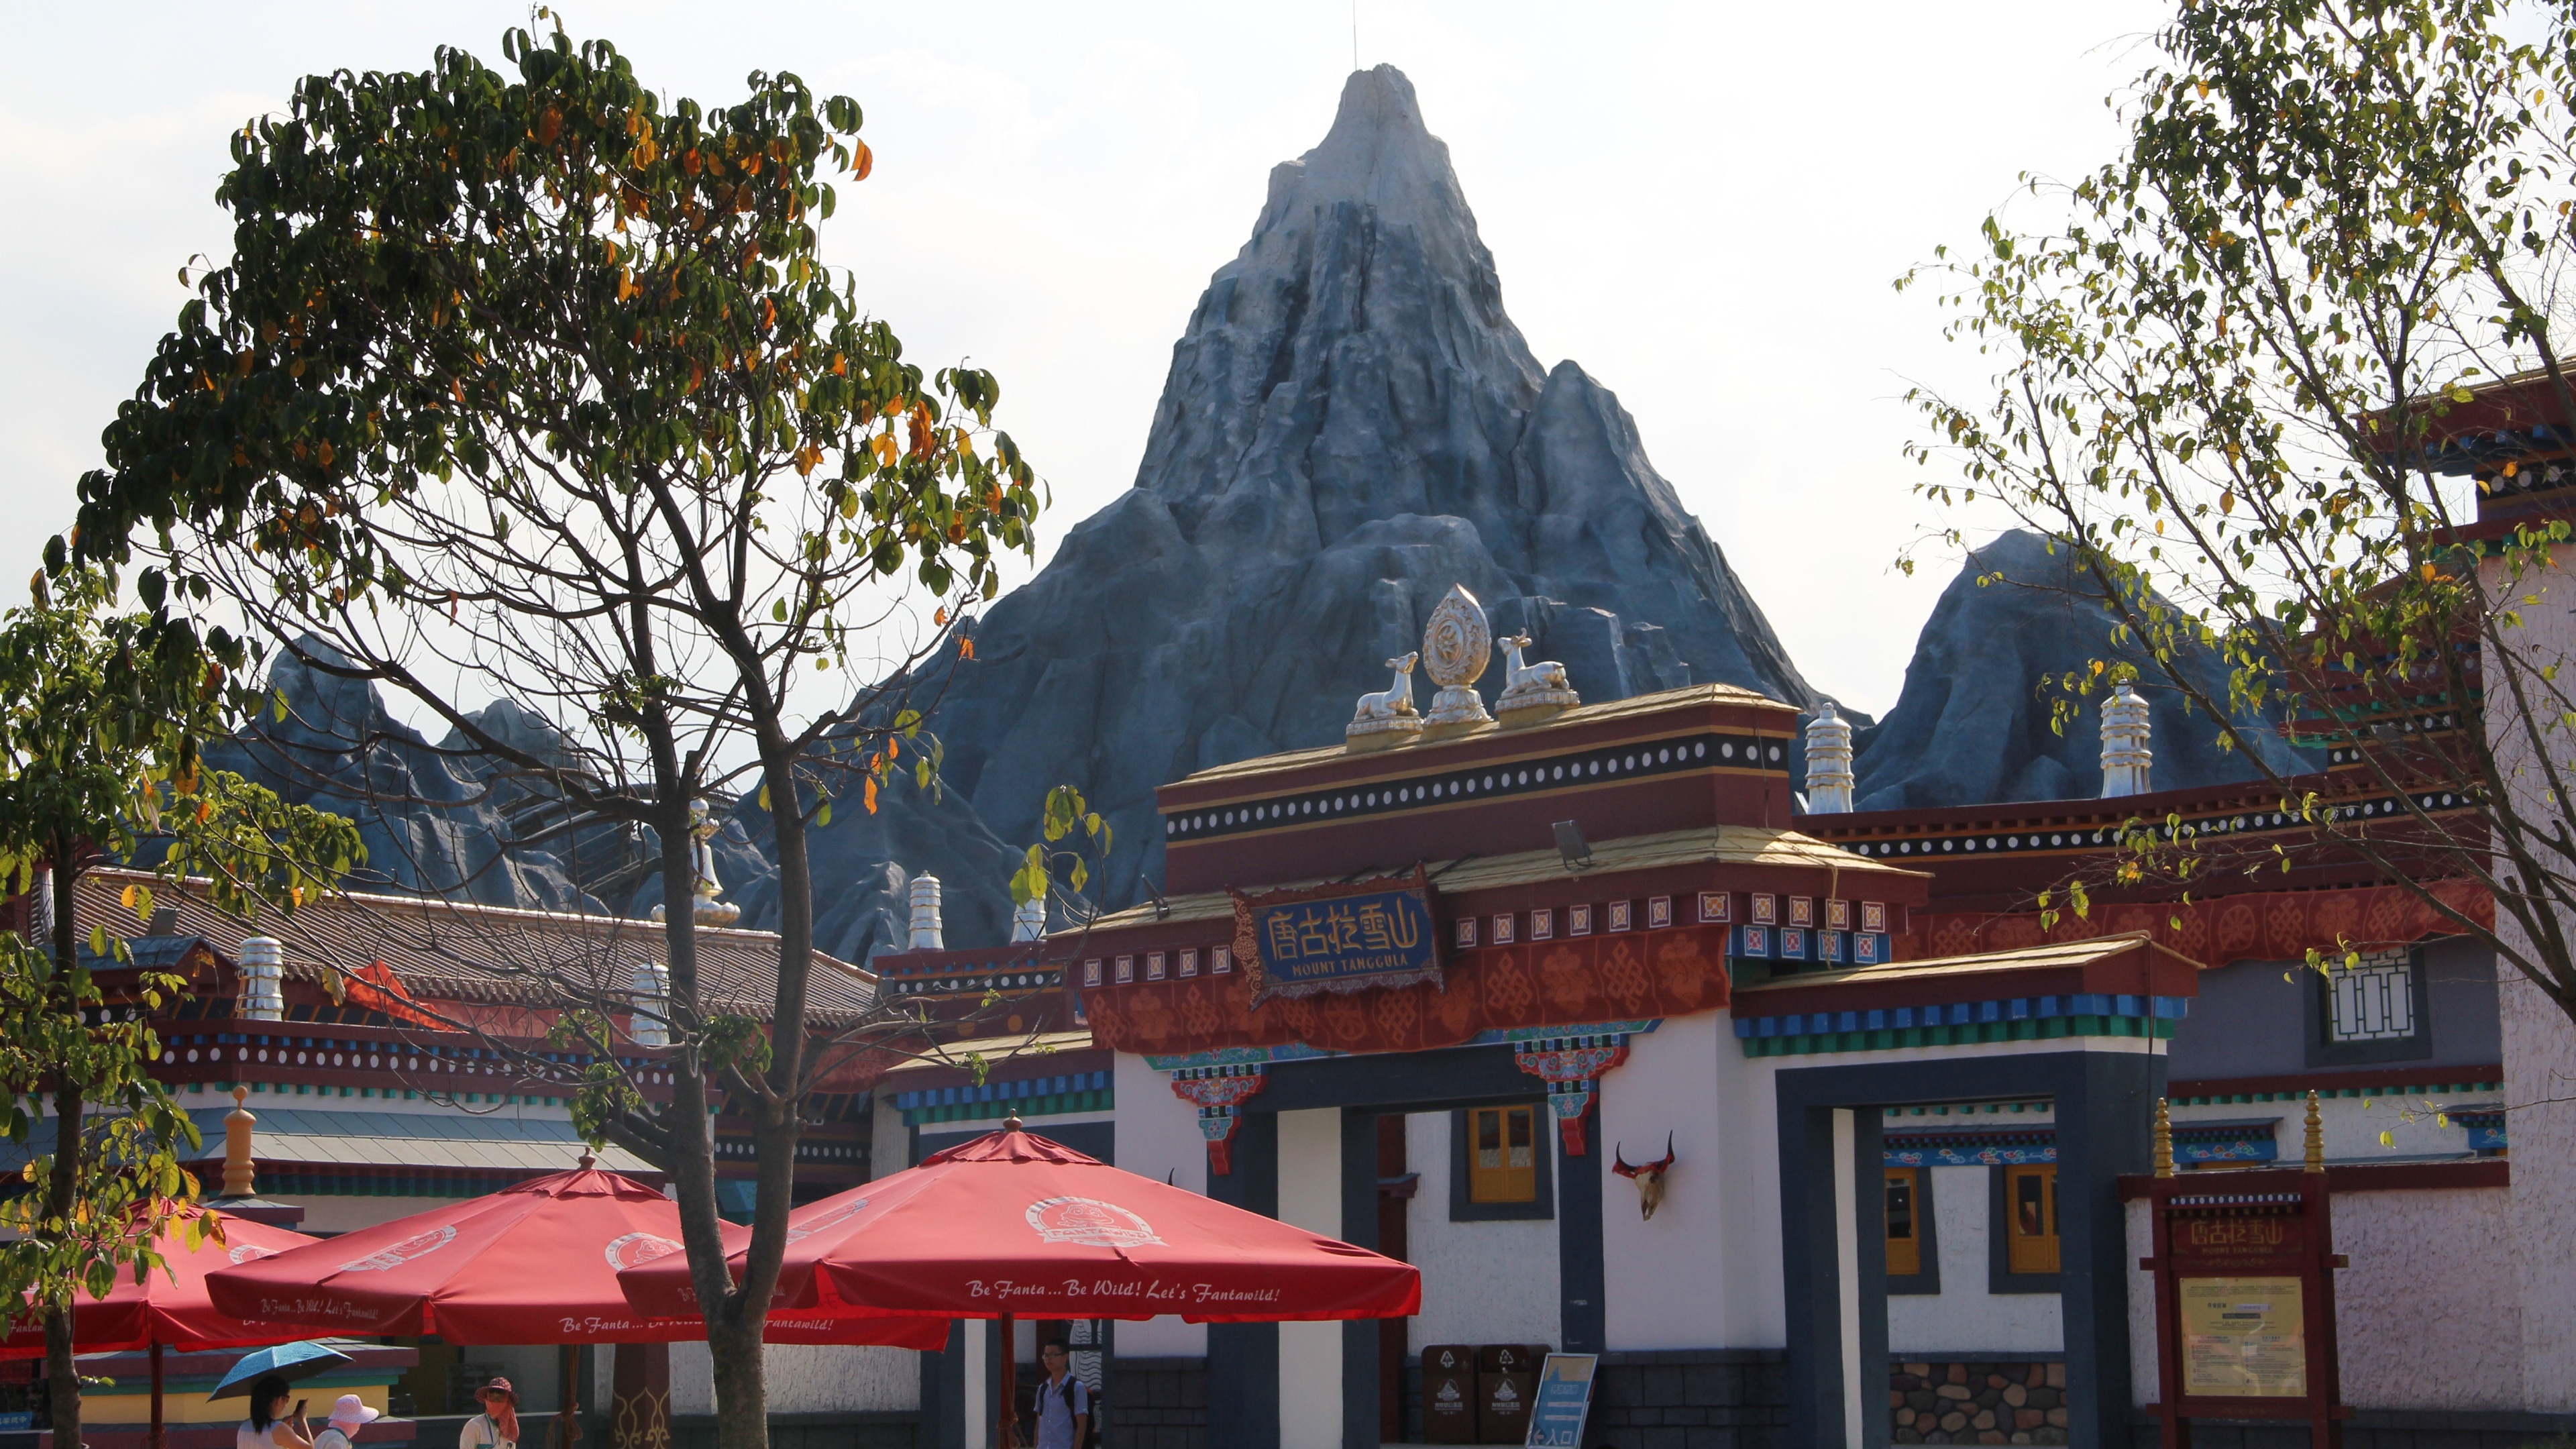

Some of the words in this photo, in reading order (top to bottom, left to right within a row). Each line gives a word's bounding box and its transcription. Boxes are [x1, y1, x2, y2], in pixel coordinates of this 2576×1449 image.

[1268, 897, 1418, 961] 唐古拉雪山
[1293, 961, 1335, 977] MOUNT
[1342, 953, 1408, 971] TANGGULA
[1052, 1228, 1147, 1238] FANTAWILD
[2192, 1218, 2282, 1245] 唐古拉雪山
[965, 1280, 990, 1297] Be
[1063, 1279, 1087, 1296] Be
[1093, 1280, 1141, 1296] Wild!
[1146, 1280, 1186, 1299] Let's
[1193, 1283, 1281, 1303] Fantawild!
[261, 1299, 270, 1313] Be
[343, 1301, 378, 1320] Fantawild!
[559, 1318, 581, 1332] Be
[1546, 1428, 1572, 1446] 入口
